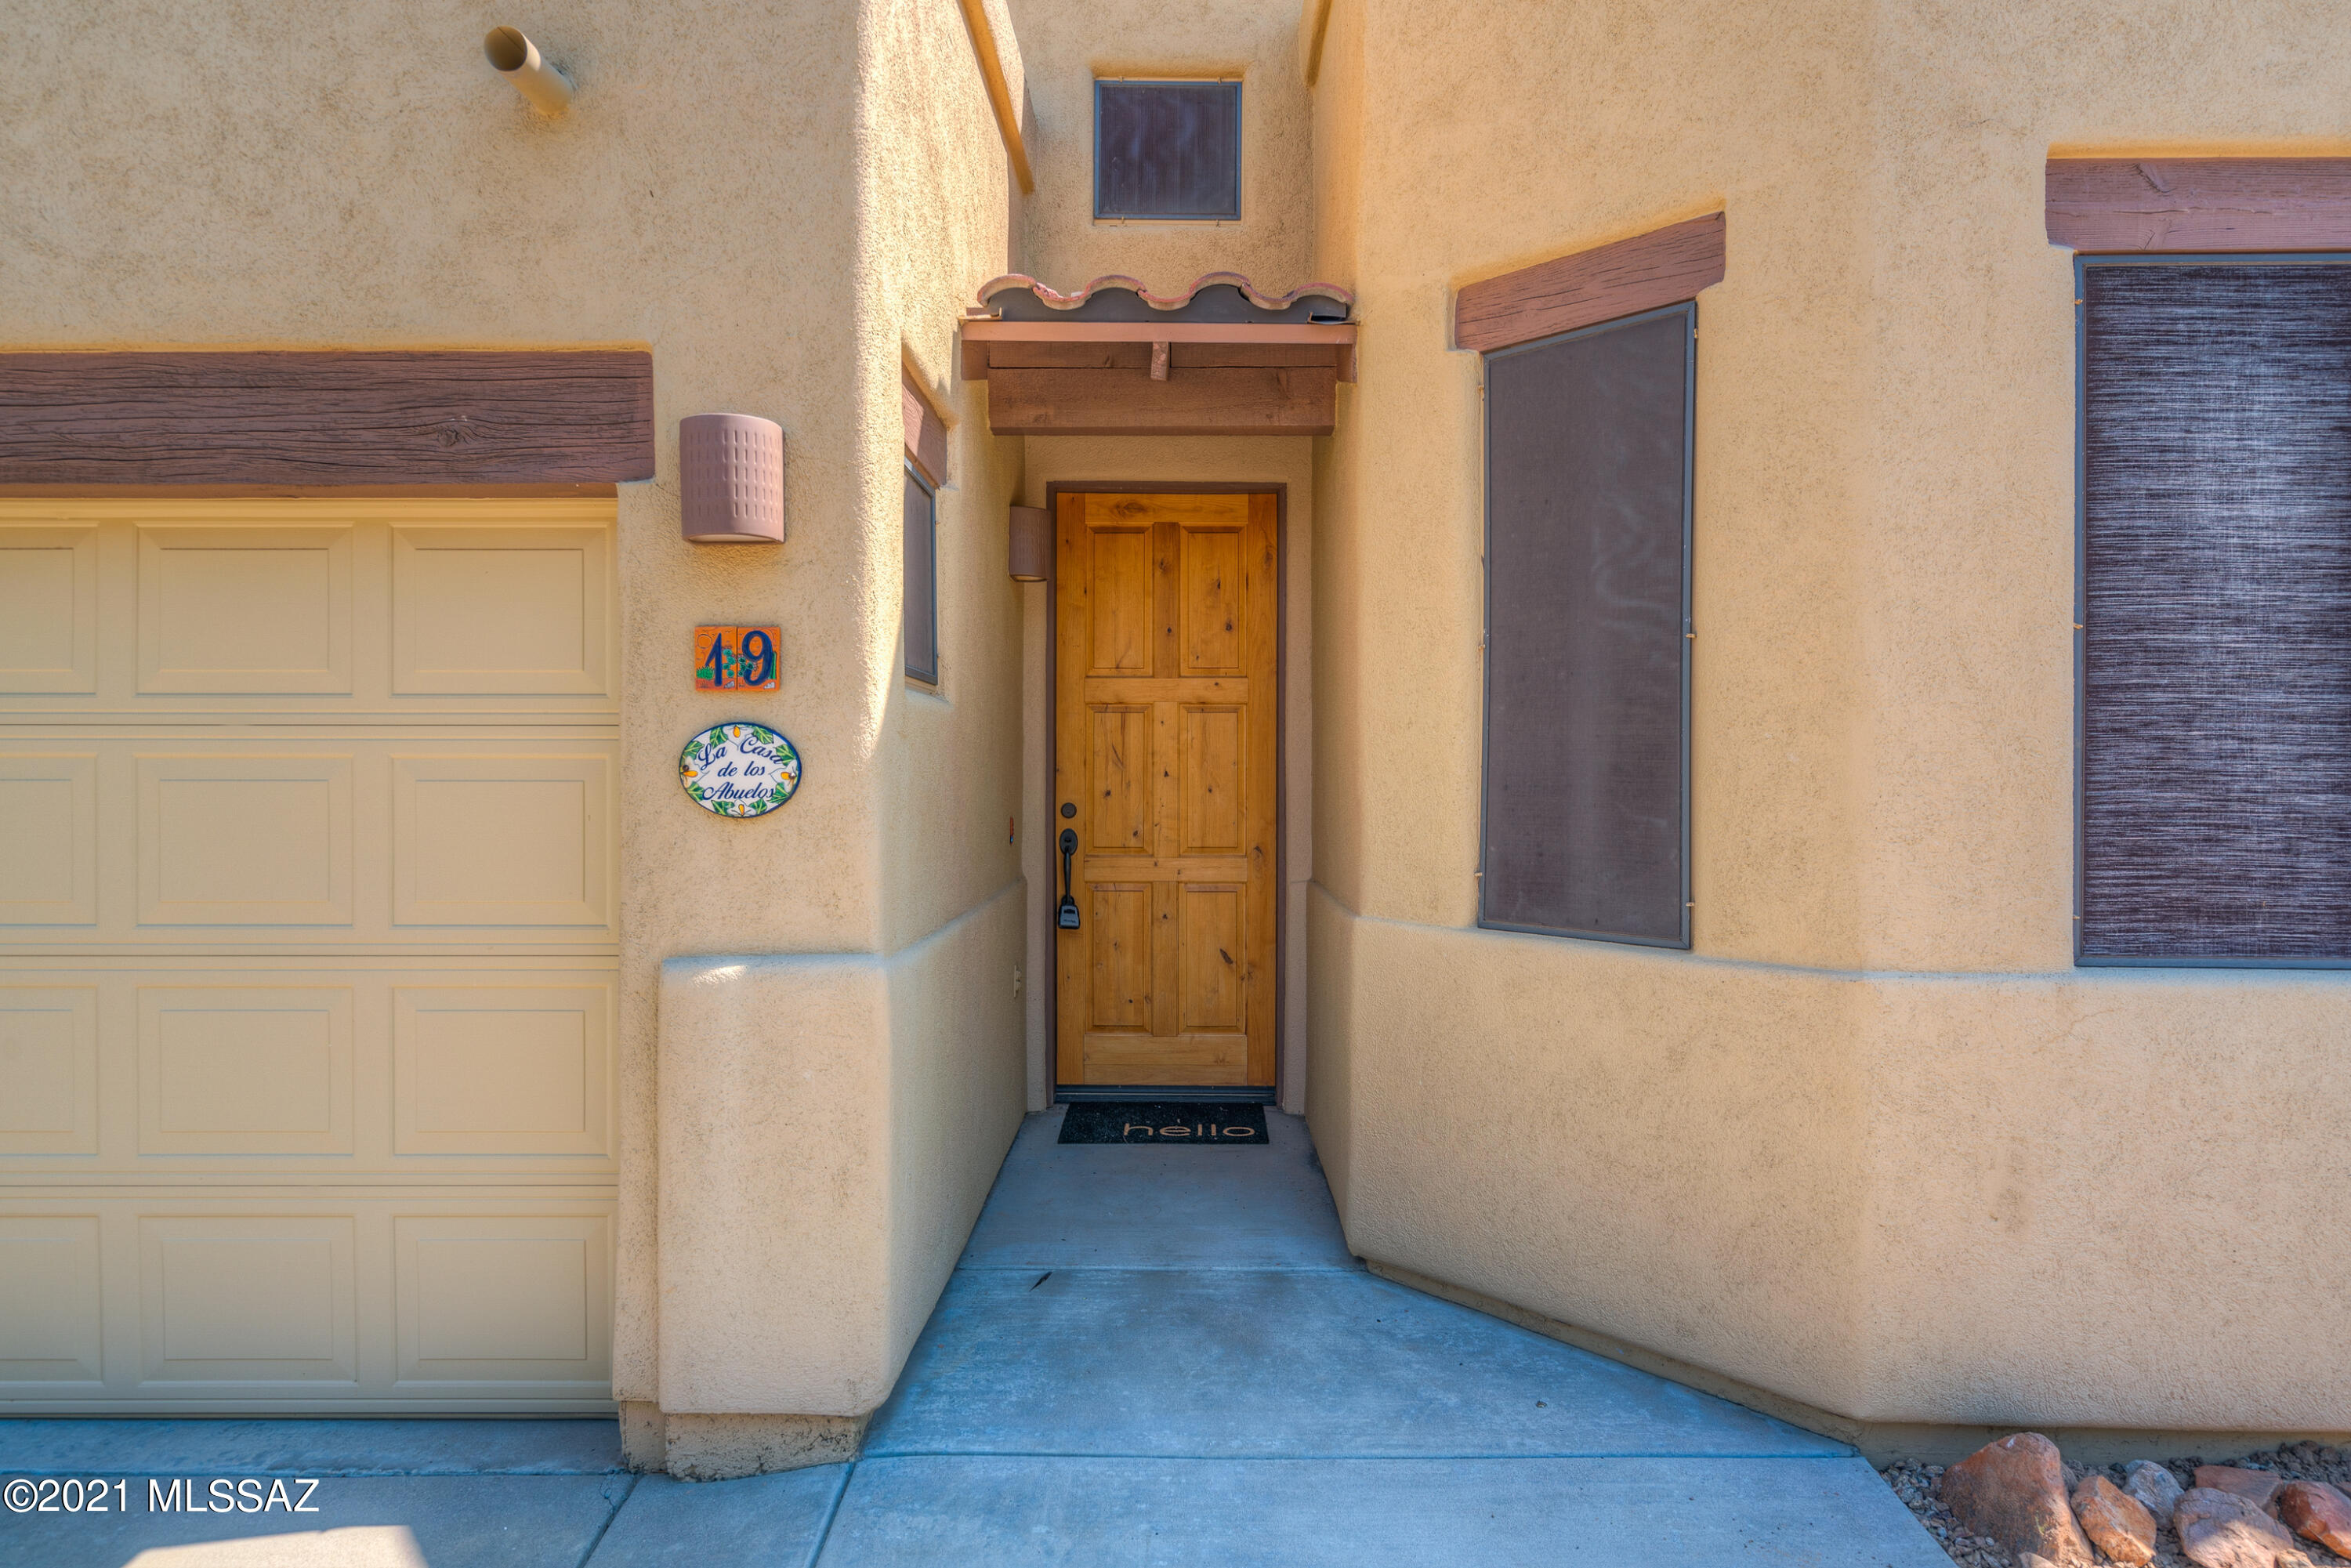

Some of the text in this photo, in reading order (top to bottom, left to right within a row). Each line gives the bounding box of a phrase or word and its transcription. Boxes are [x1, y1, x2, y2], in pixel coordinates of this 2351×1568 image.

[705, 629, 773, 687] 19
[697, 736, 783, 771] La Casa
[717, 760, 766, 777] de los
[702, 781, 774, 800] Abuelos
[1123, 1123, 1255, 1136] hello
